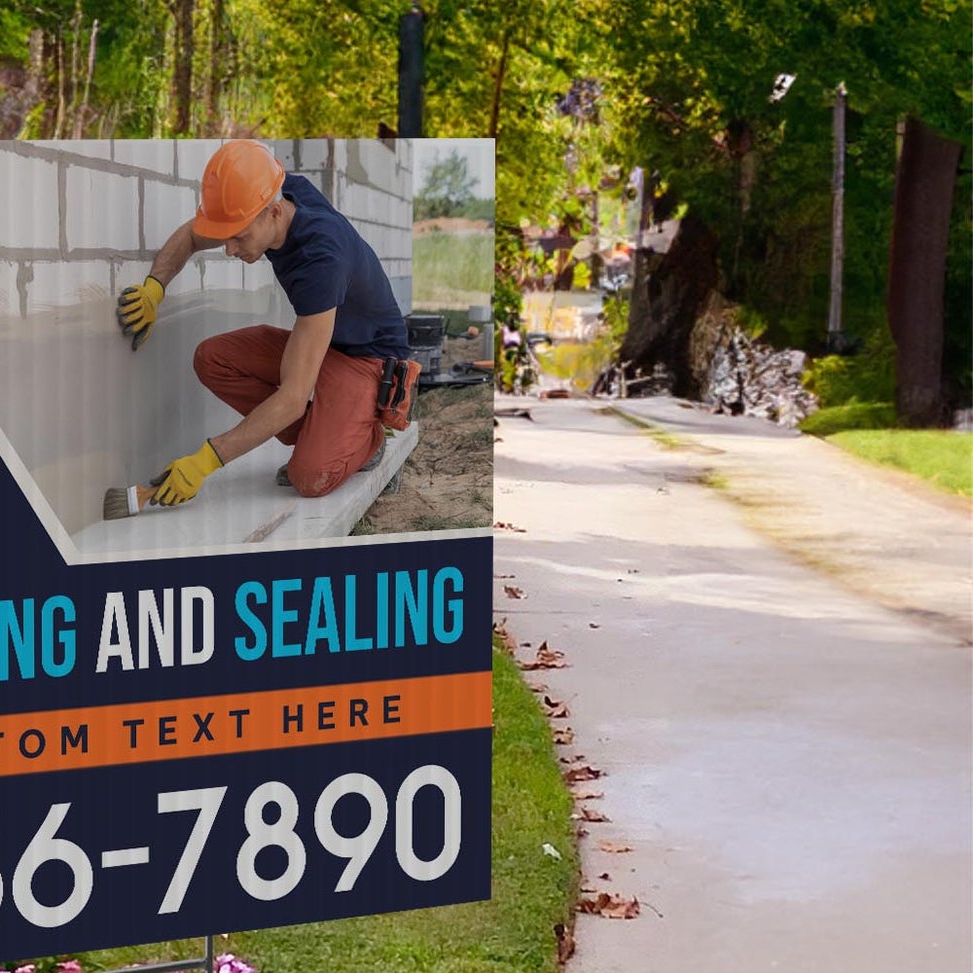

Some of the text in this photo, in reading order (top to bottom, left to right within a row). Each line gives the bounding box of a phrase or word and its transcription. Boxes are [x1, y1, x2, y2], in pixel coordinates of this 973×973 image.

[95, 586, 215, 673] AND
[234, 566, 464, 661] SEALING
[122, 708, 250, 749] TEXT
[282, 694, 403, 734] HERE
